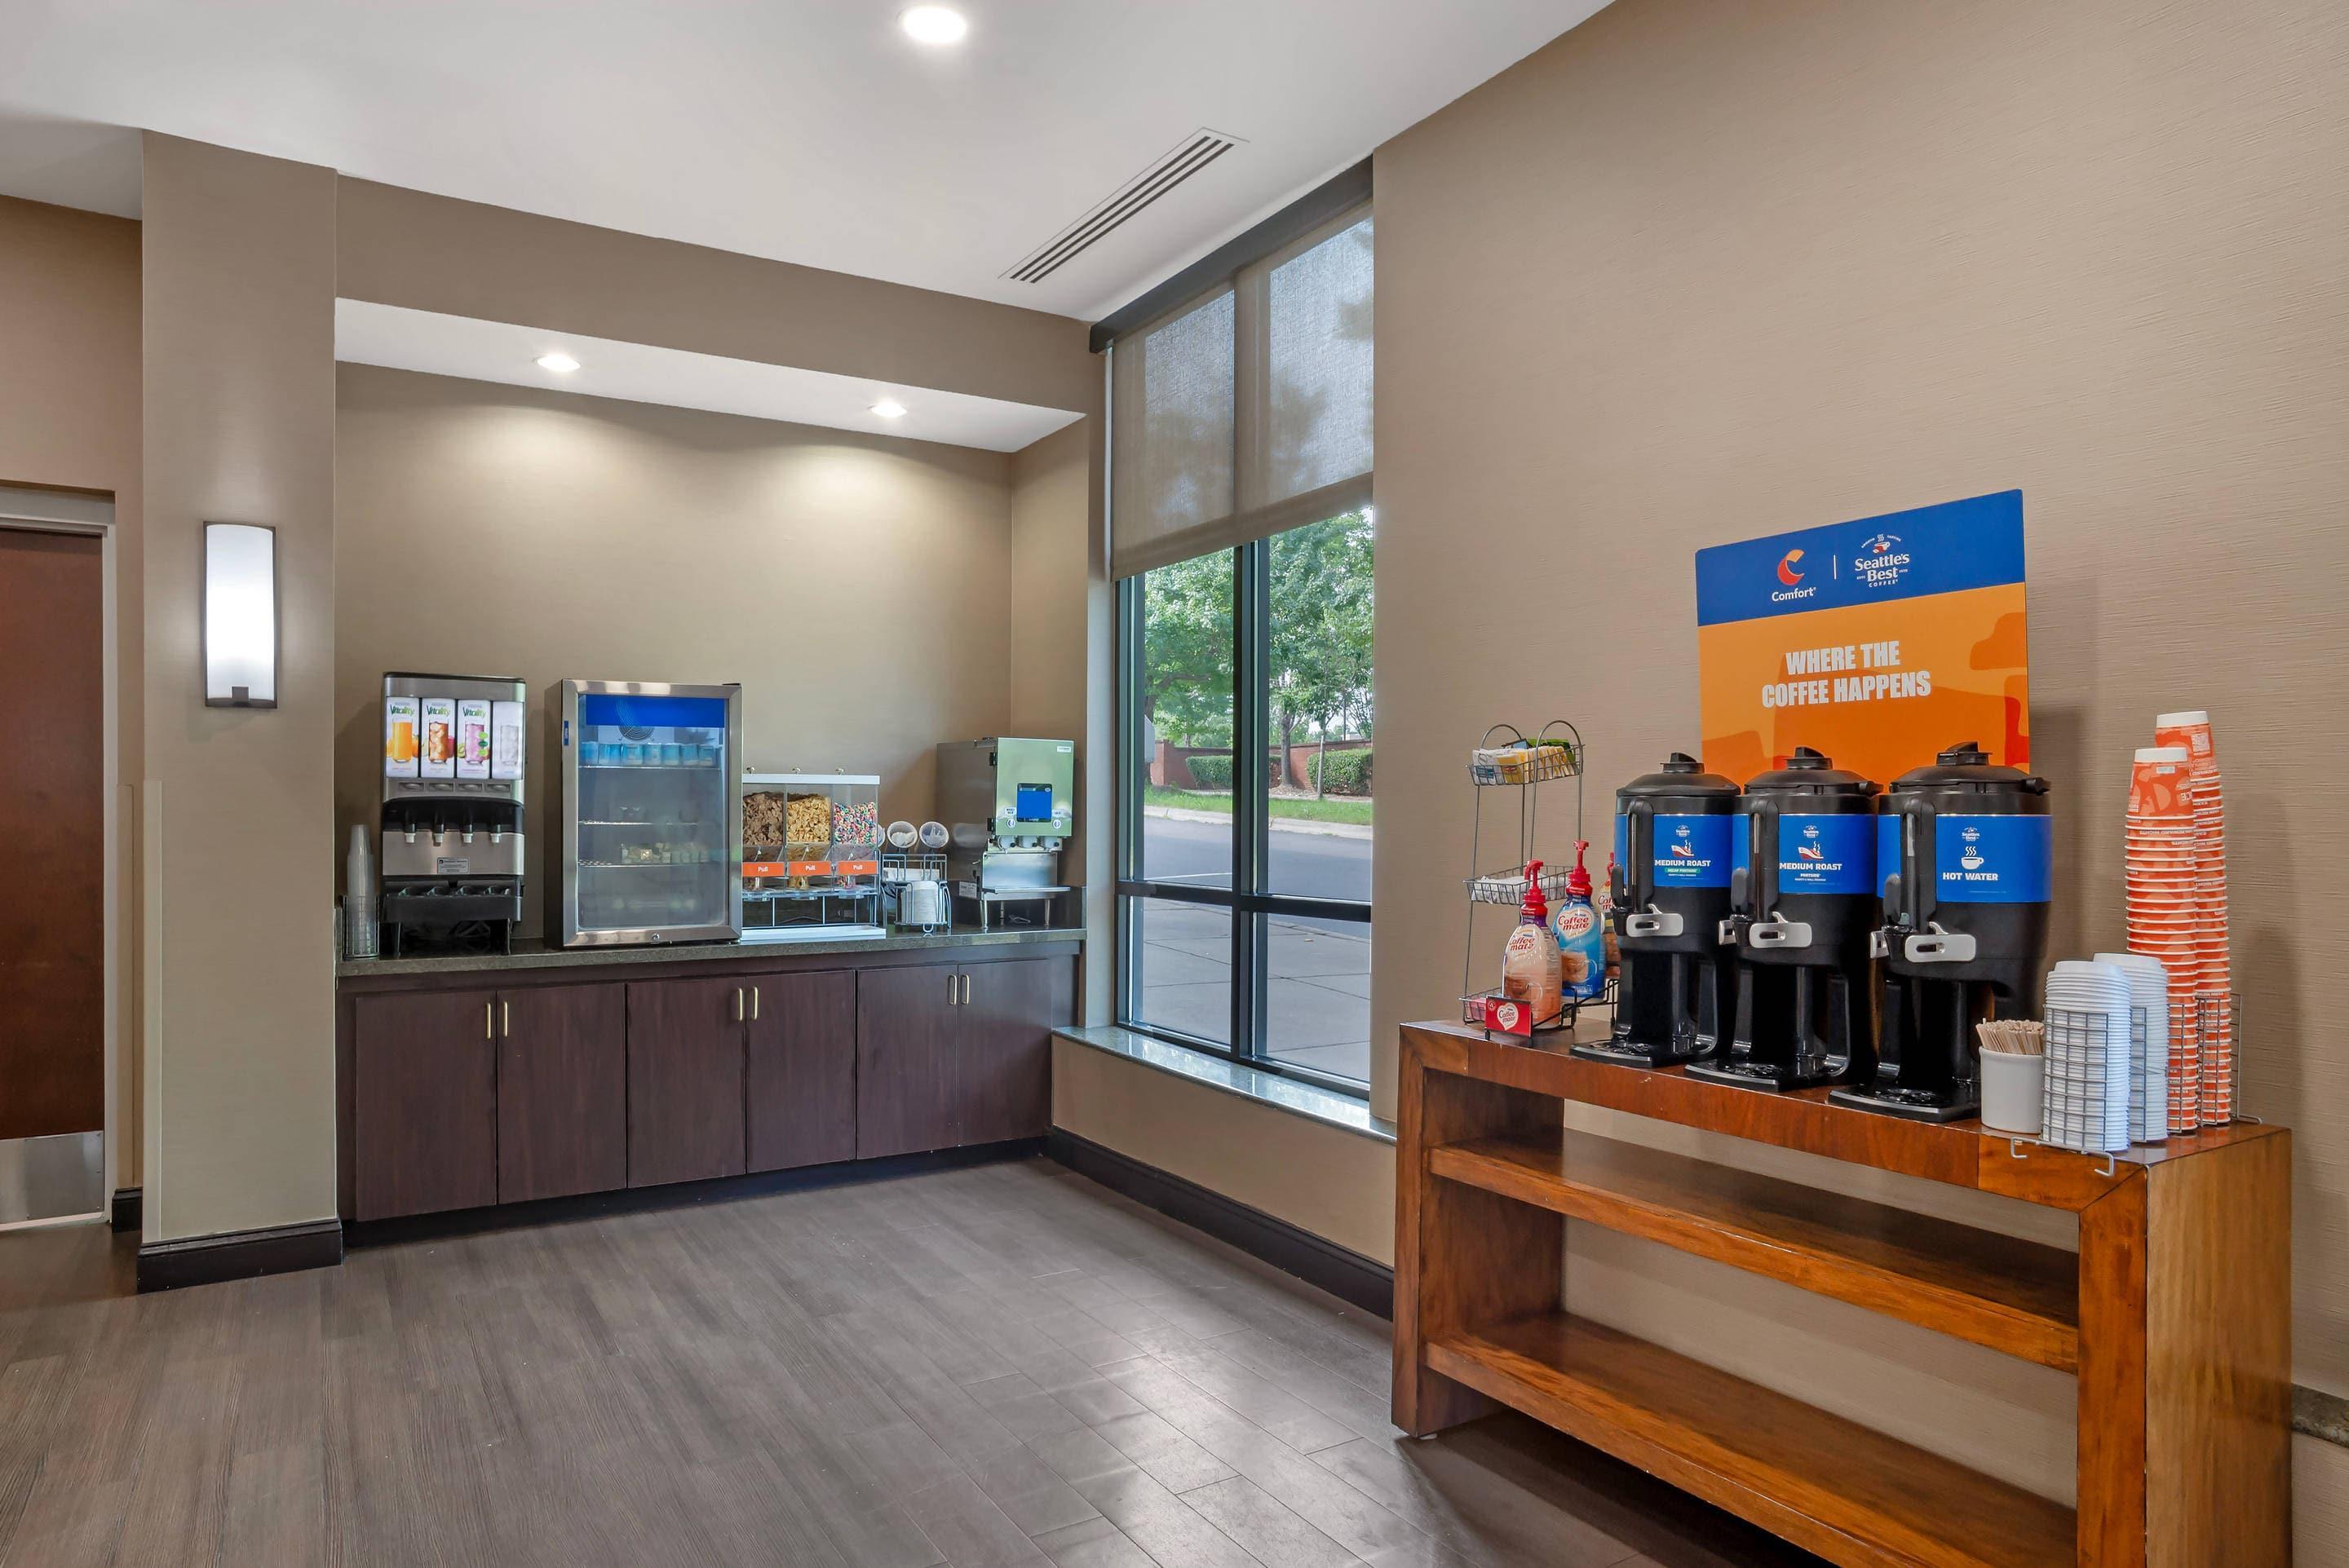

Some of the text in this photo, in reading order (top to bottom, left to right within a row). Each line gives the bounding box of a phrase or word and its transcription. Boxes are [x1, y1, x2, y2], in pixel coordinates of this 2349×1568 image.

[1855, 554, 1909, 572] Seattle's
[1867, 567, 1898, 582] Best
[1785, 640, 1900, 675] WHERE THE
[1762, 670, 1931, 709] COFFEE HAPPENS
[390, 704, 414, 716] Vitality
[427, 704, 450, 717] Vitality
[462, 706, 486, 718] Vitality
[1965, 872, 1998, 881] WATER
[1558, 916, 1589, 925] Coffee
[1563, 922, 1589, 930] mate
[1511, 943, 1534, 951] mate
[1498, 1010, 1515, 1018] Coffee
